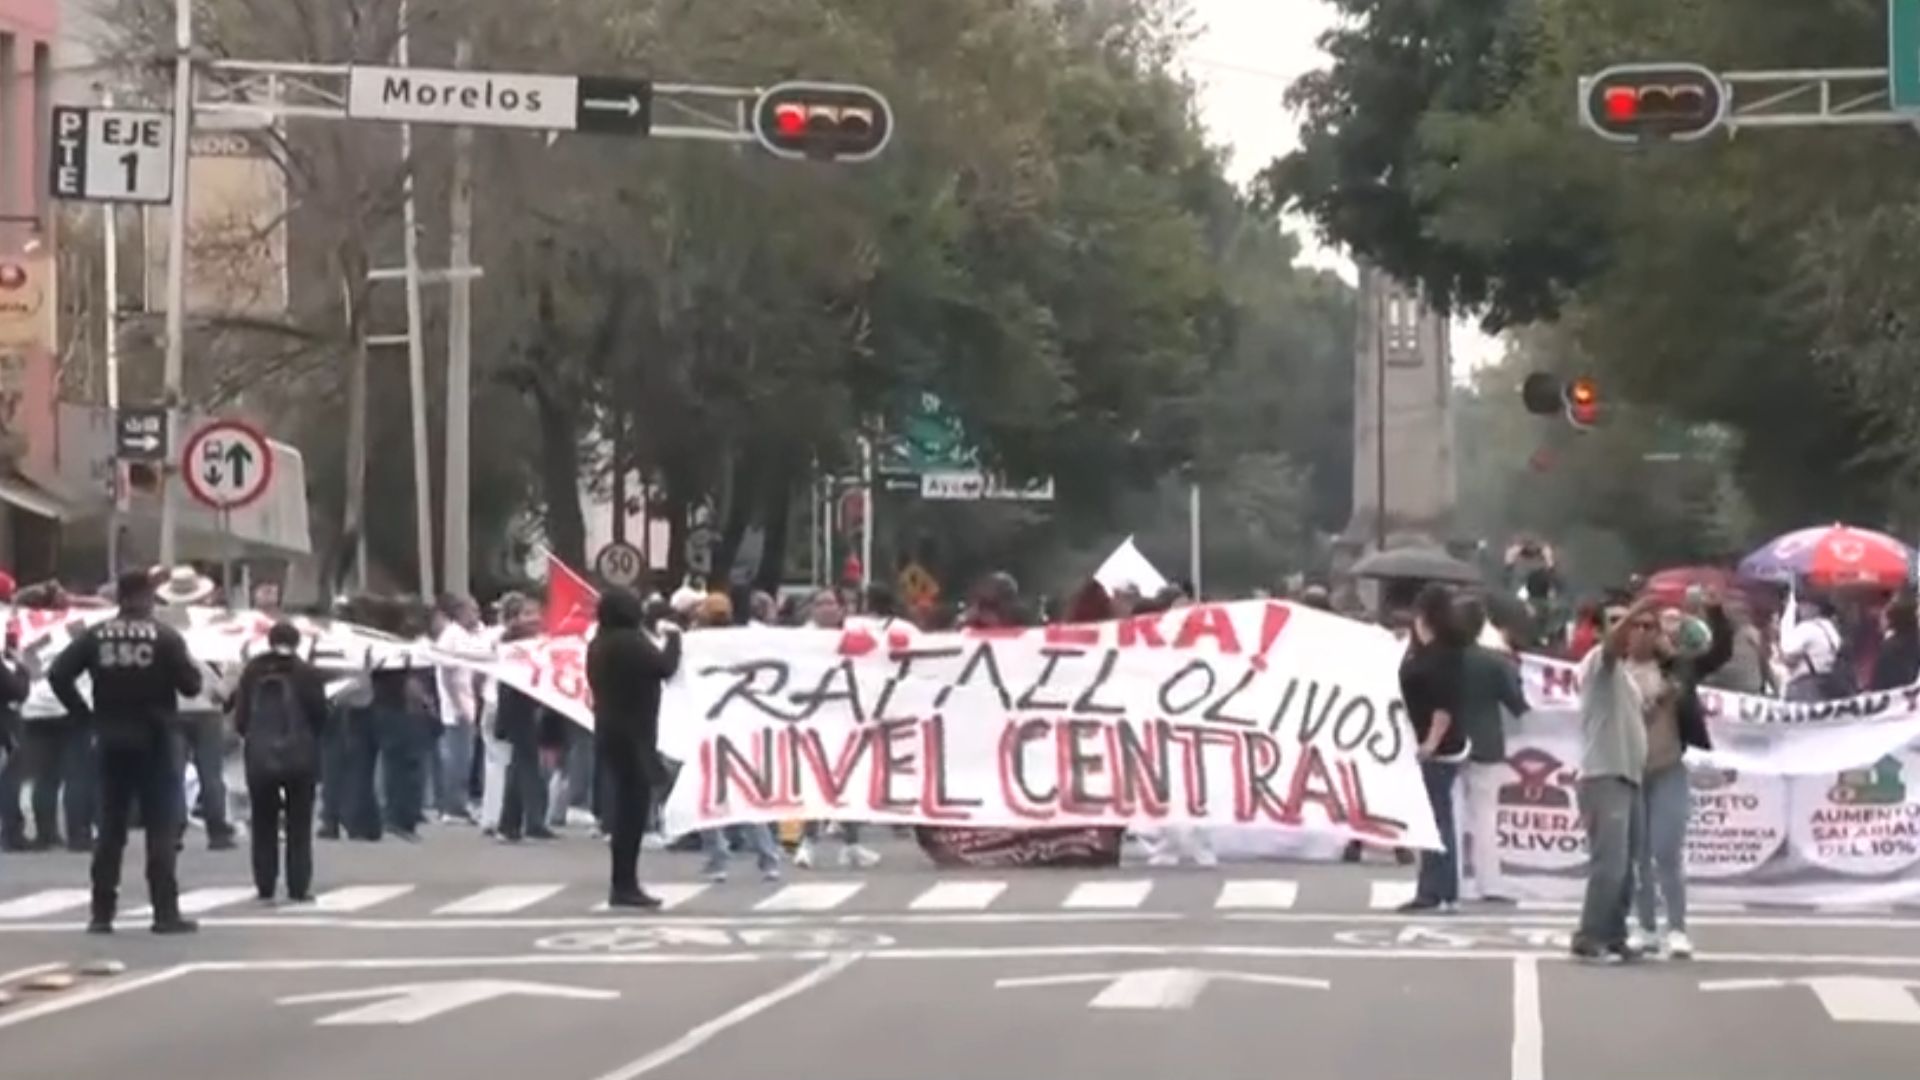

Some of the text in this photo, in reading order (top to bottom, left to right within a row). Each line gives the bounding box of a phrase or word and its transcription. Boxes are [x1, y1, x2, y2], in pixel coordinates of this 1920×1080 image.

[382, 76, 542, 112] Morelos
[102, 119, 160, 147] EJE
[58, 112, 82, 194] PTE
[119, 153, 138, 192] 1
[607, 549, 633, 576] 50
[99, 642, 153, 668] SSC
[1158, 659, 1405, 765] OLIVOS
[700, 715, 1408, 838] NIVEL CENTRAL
